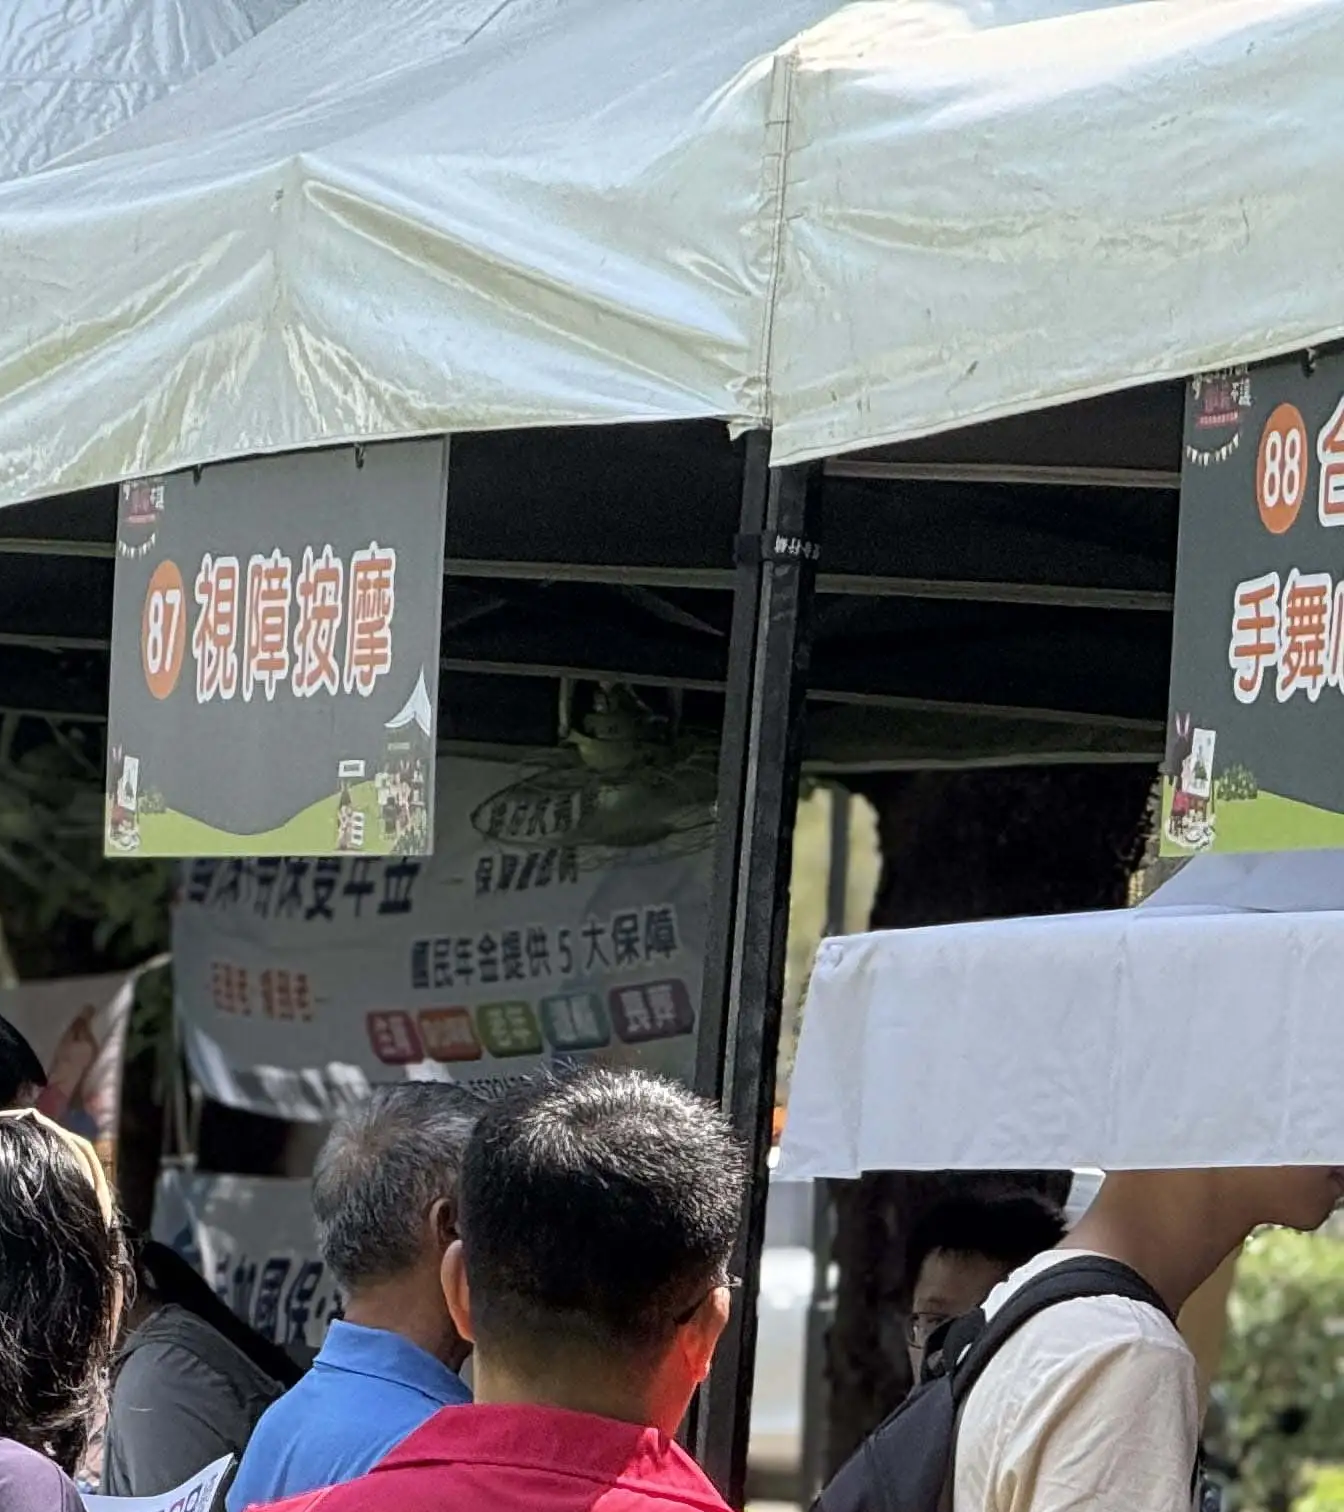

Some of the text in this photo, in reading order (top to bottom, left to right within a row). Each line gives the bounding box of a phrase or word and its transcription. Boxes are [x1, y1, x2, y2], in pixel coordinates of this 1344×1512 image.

[1263, 427, 1302, 510] 88
[147, 541, 397, 704] 87 視障按摩
[1230, 568, 1344, 704] 手舞
